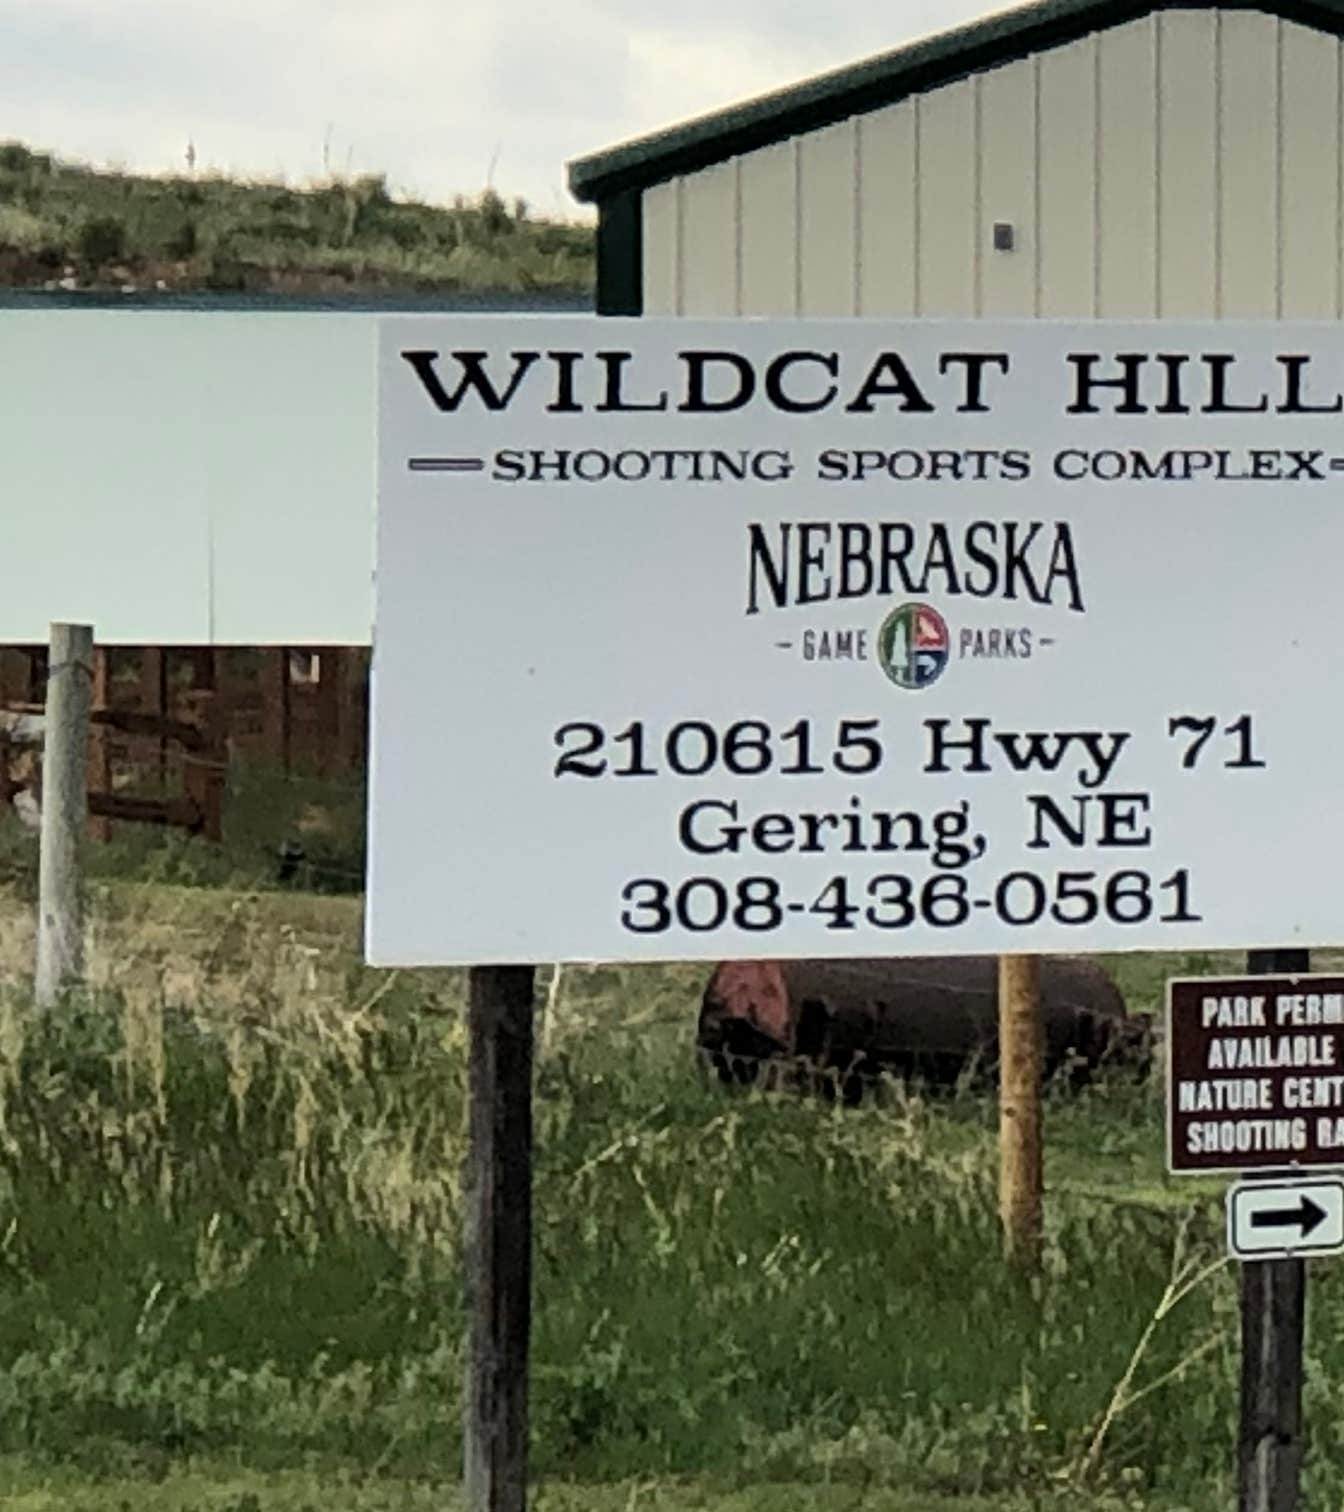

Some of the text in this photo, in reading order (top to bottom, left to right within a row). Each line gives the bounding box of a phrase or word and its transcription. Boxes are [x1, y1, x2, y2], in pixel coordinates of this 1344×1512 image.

[401, 350, 1009, 414] WILDCAT
[492, 448, 1326, 481] SHOOTING SPORTS COMPLEX
[746, 520, 1086, 614] NEBRASKA
[803, 627, 1032, 661] GAME PARKS
[554, 715, 1266, 788] 210615 Hwy 71
[679, 793, 1152, 868] Gering, NE
[620, 869, 1203, 934] 308-436-0561
[1202, 996, 1266, 1027] PARK
[1207, 1035, 1335, 1069] AVAILABLE
[1178, 1078, 1273, 1112] NATURE
[1187, 1118, 1307, 1153] SHOOTING
